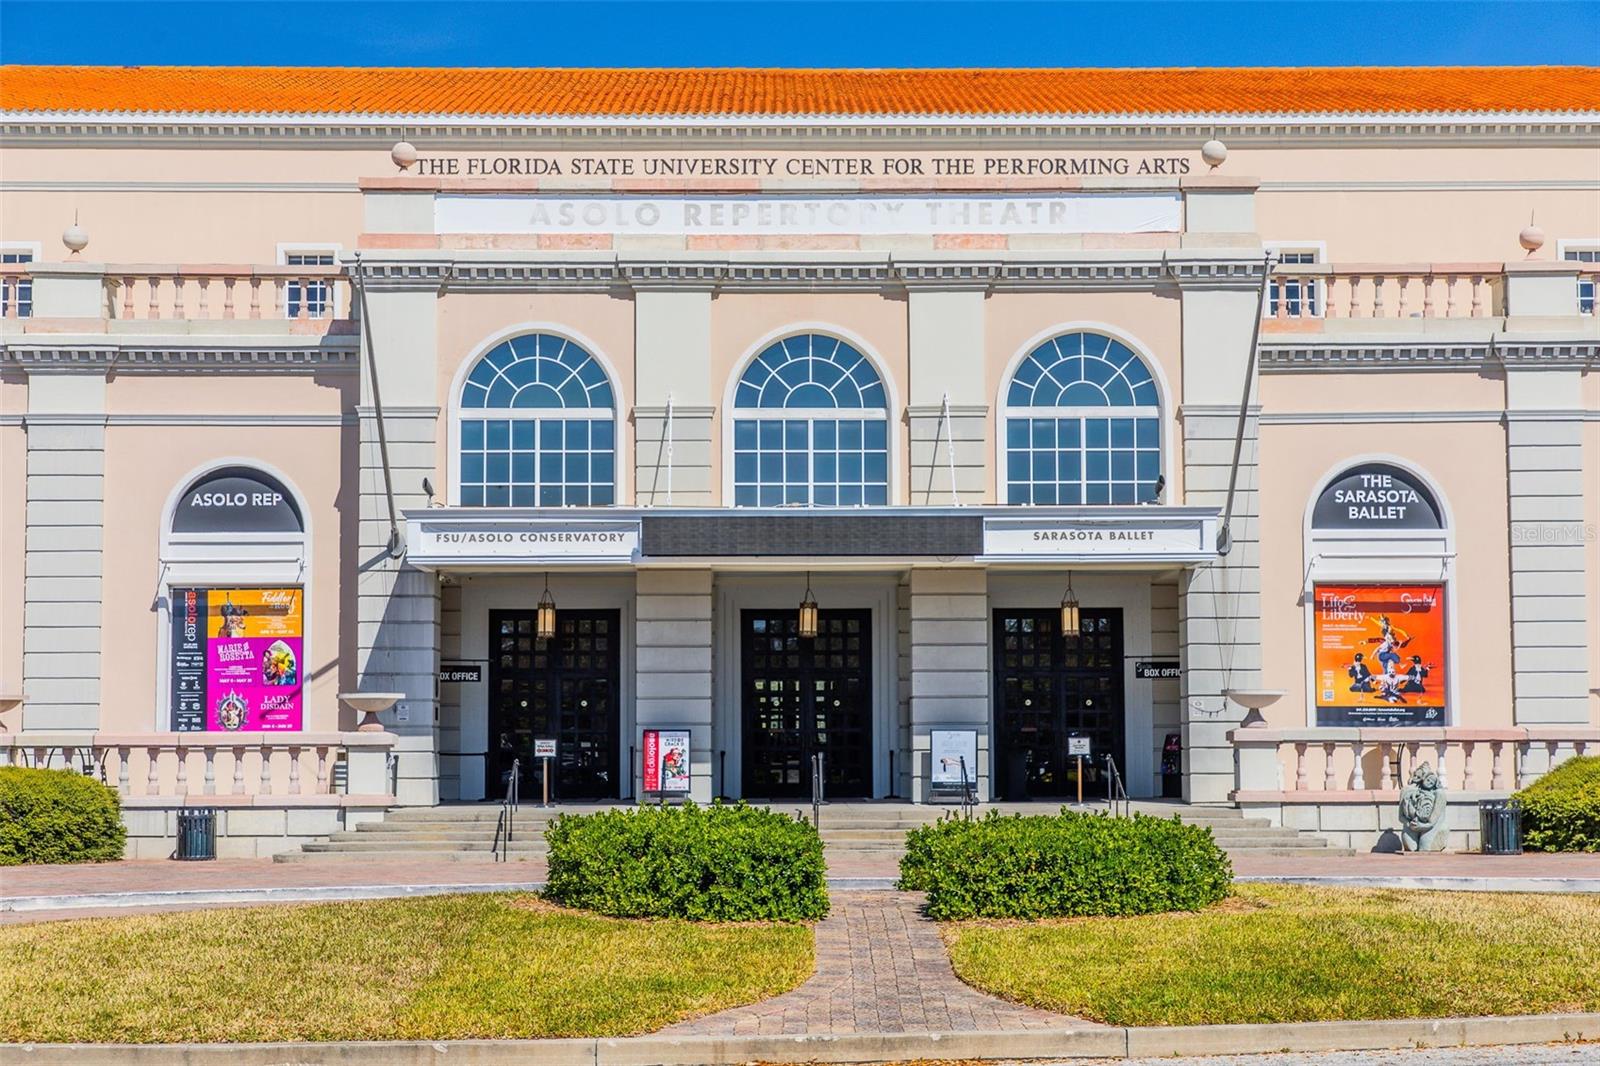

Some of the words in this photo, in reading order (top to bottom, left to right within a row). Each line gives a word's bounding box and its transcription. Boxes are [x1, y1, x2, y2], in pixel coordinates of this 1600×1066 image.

[416, 157, 459, 176] THE
[466, 157, 562, 176] FLORIDA
[571, 157, 634, 176] STATE
[643, 157, 778, 176] UNIVERSITY
[786, 157, 873, 176] CENTER
[882, 157, 925, 176] FOR
[932, 157, 975, 176] THE
[984, 157, 1129, 176] PERFORMING
[1136, 157, 1190, 176] ARTS
[529, 202, 661, 227] ASOLO
[684, 202, 905, 227] REPERTORY
[1360, 474, 1392, 487] THE
[191, 493, 247, 507] ASOLO
[252, 493, 283, 506] REP
[1335, 490, 1419, 503] SARASOTA
[1349, 506, 1407, 519] BALLET
[436, 532, 514, 544] FSU/ASOLO
[519, 532, 626, 544] CONSERVATORY
[1033, 530, 1103, 541] SARASOTA
[1109, 530, 1155, 541] BALLET
[1321, 609, 1365, 624] Liberty
[439, 671, 450, 681] OX
[451, 671, 479, 681] OFFICE
[1144, 668, 1160, 677] BOX
[1161, 668, 1182, 677] OFFIC
[264, 695, 290, 703] LADY
